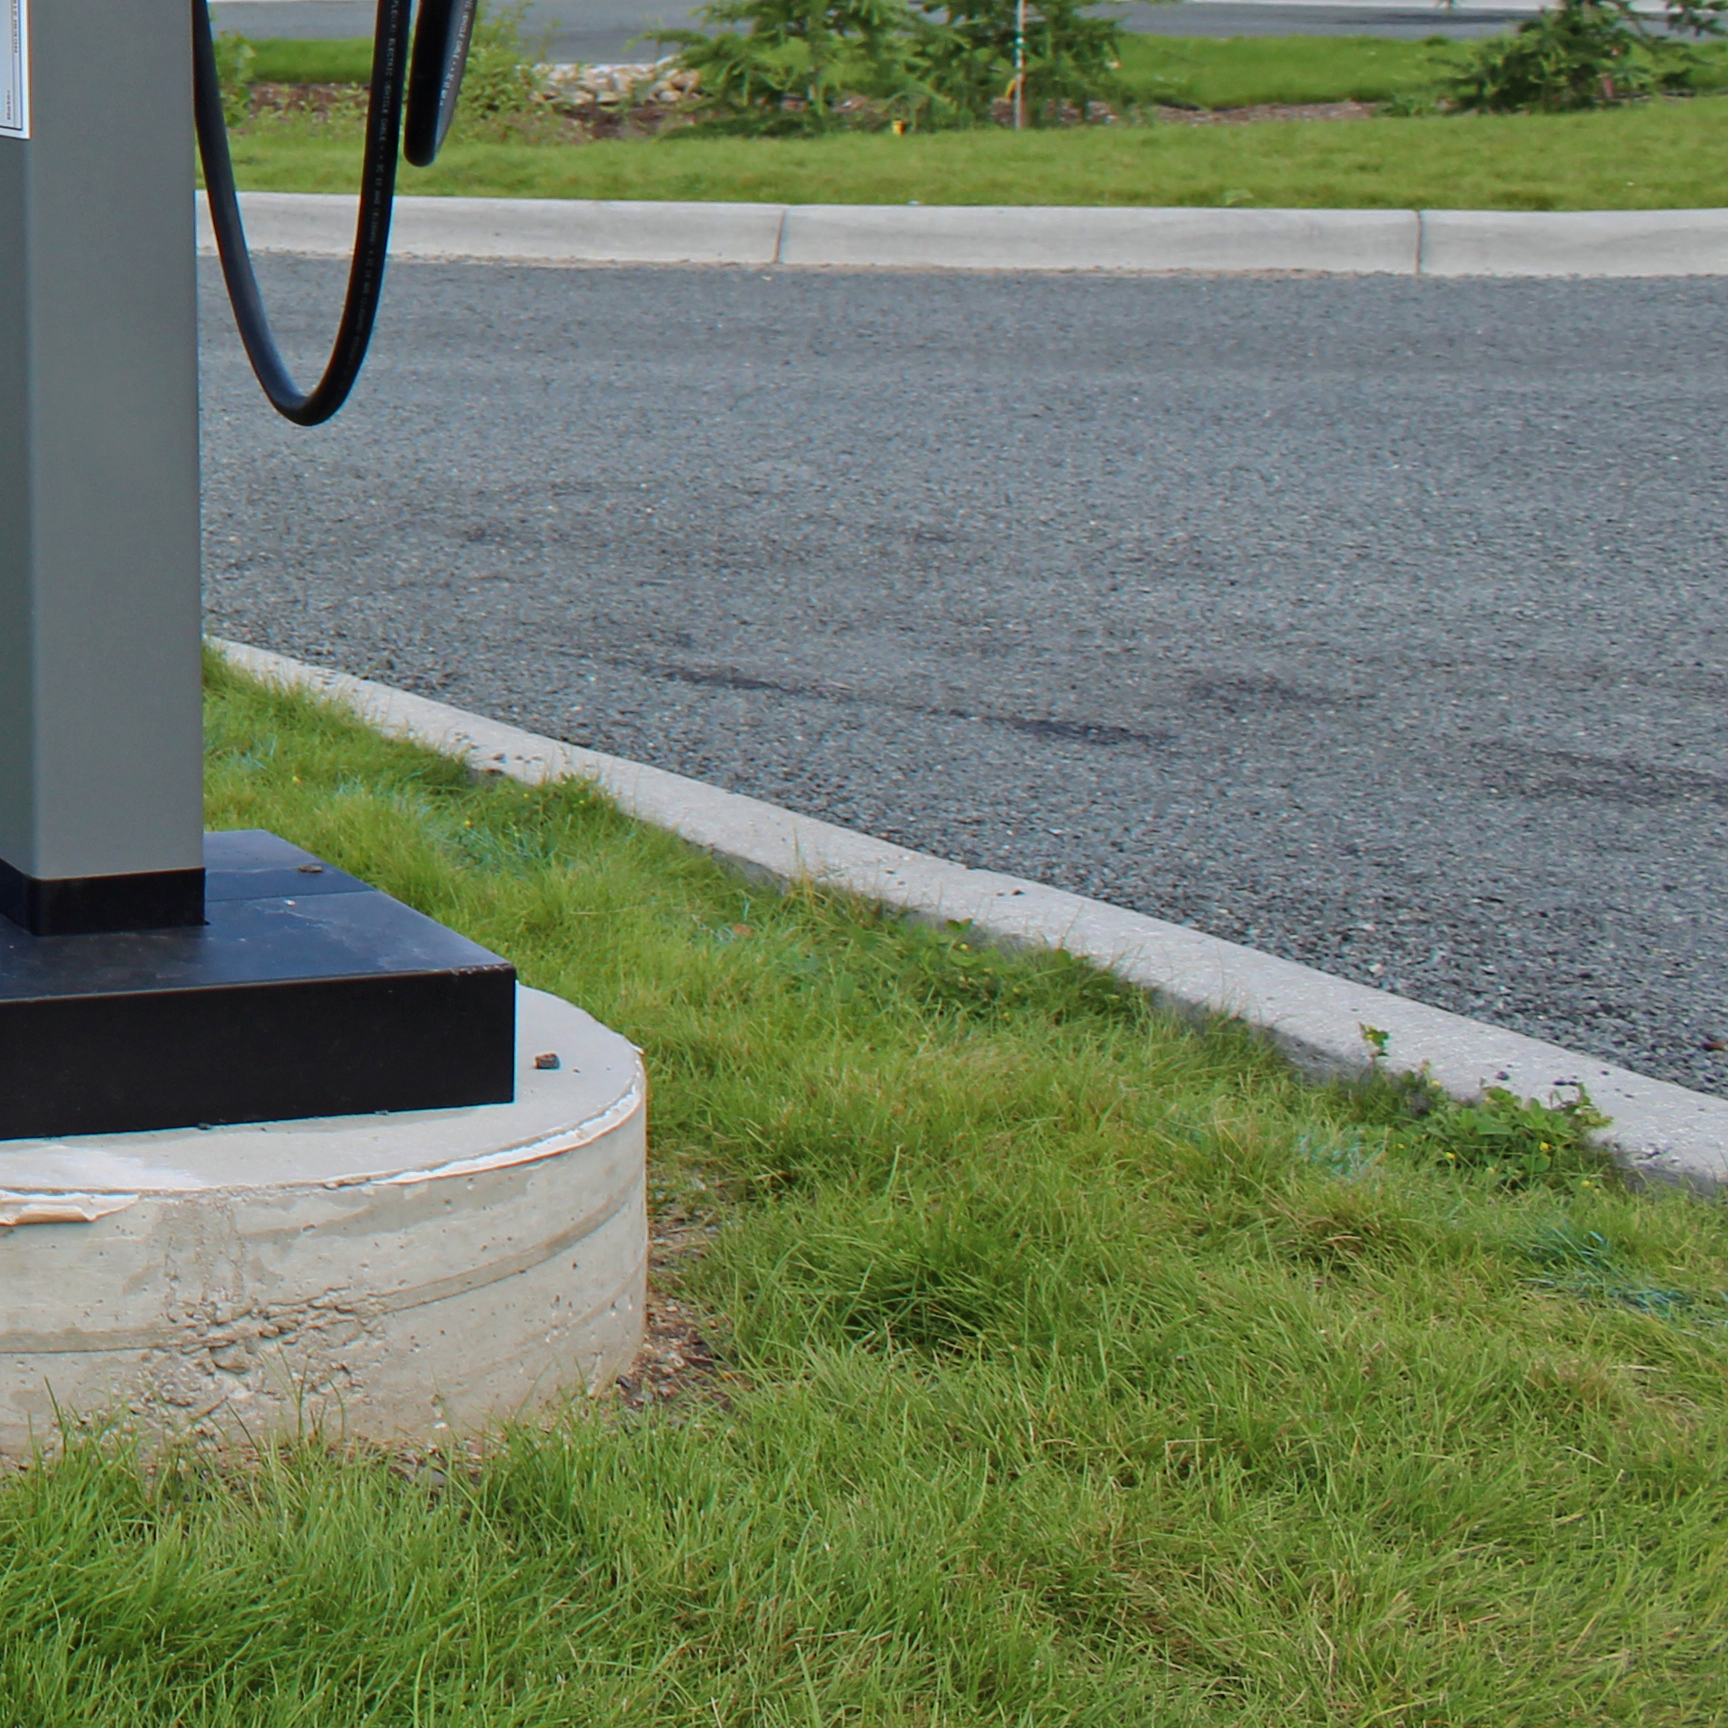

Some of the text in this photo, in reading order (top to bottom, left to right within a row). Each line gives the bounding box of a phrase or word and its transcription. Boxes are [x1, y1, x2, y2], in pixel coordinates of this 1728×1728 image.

[385, 37, 396, 77] ELECTRIC
[382, 81, 392, 114] VEHICLE
[379, 118, 388, 141] CABLE
